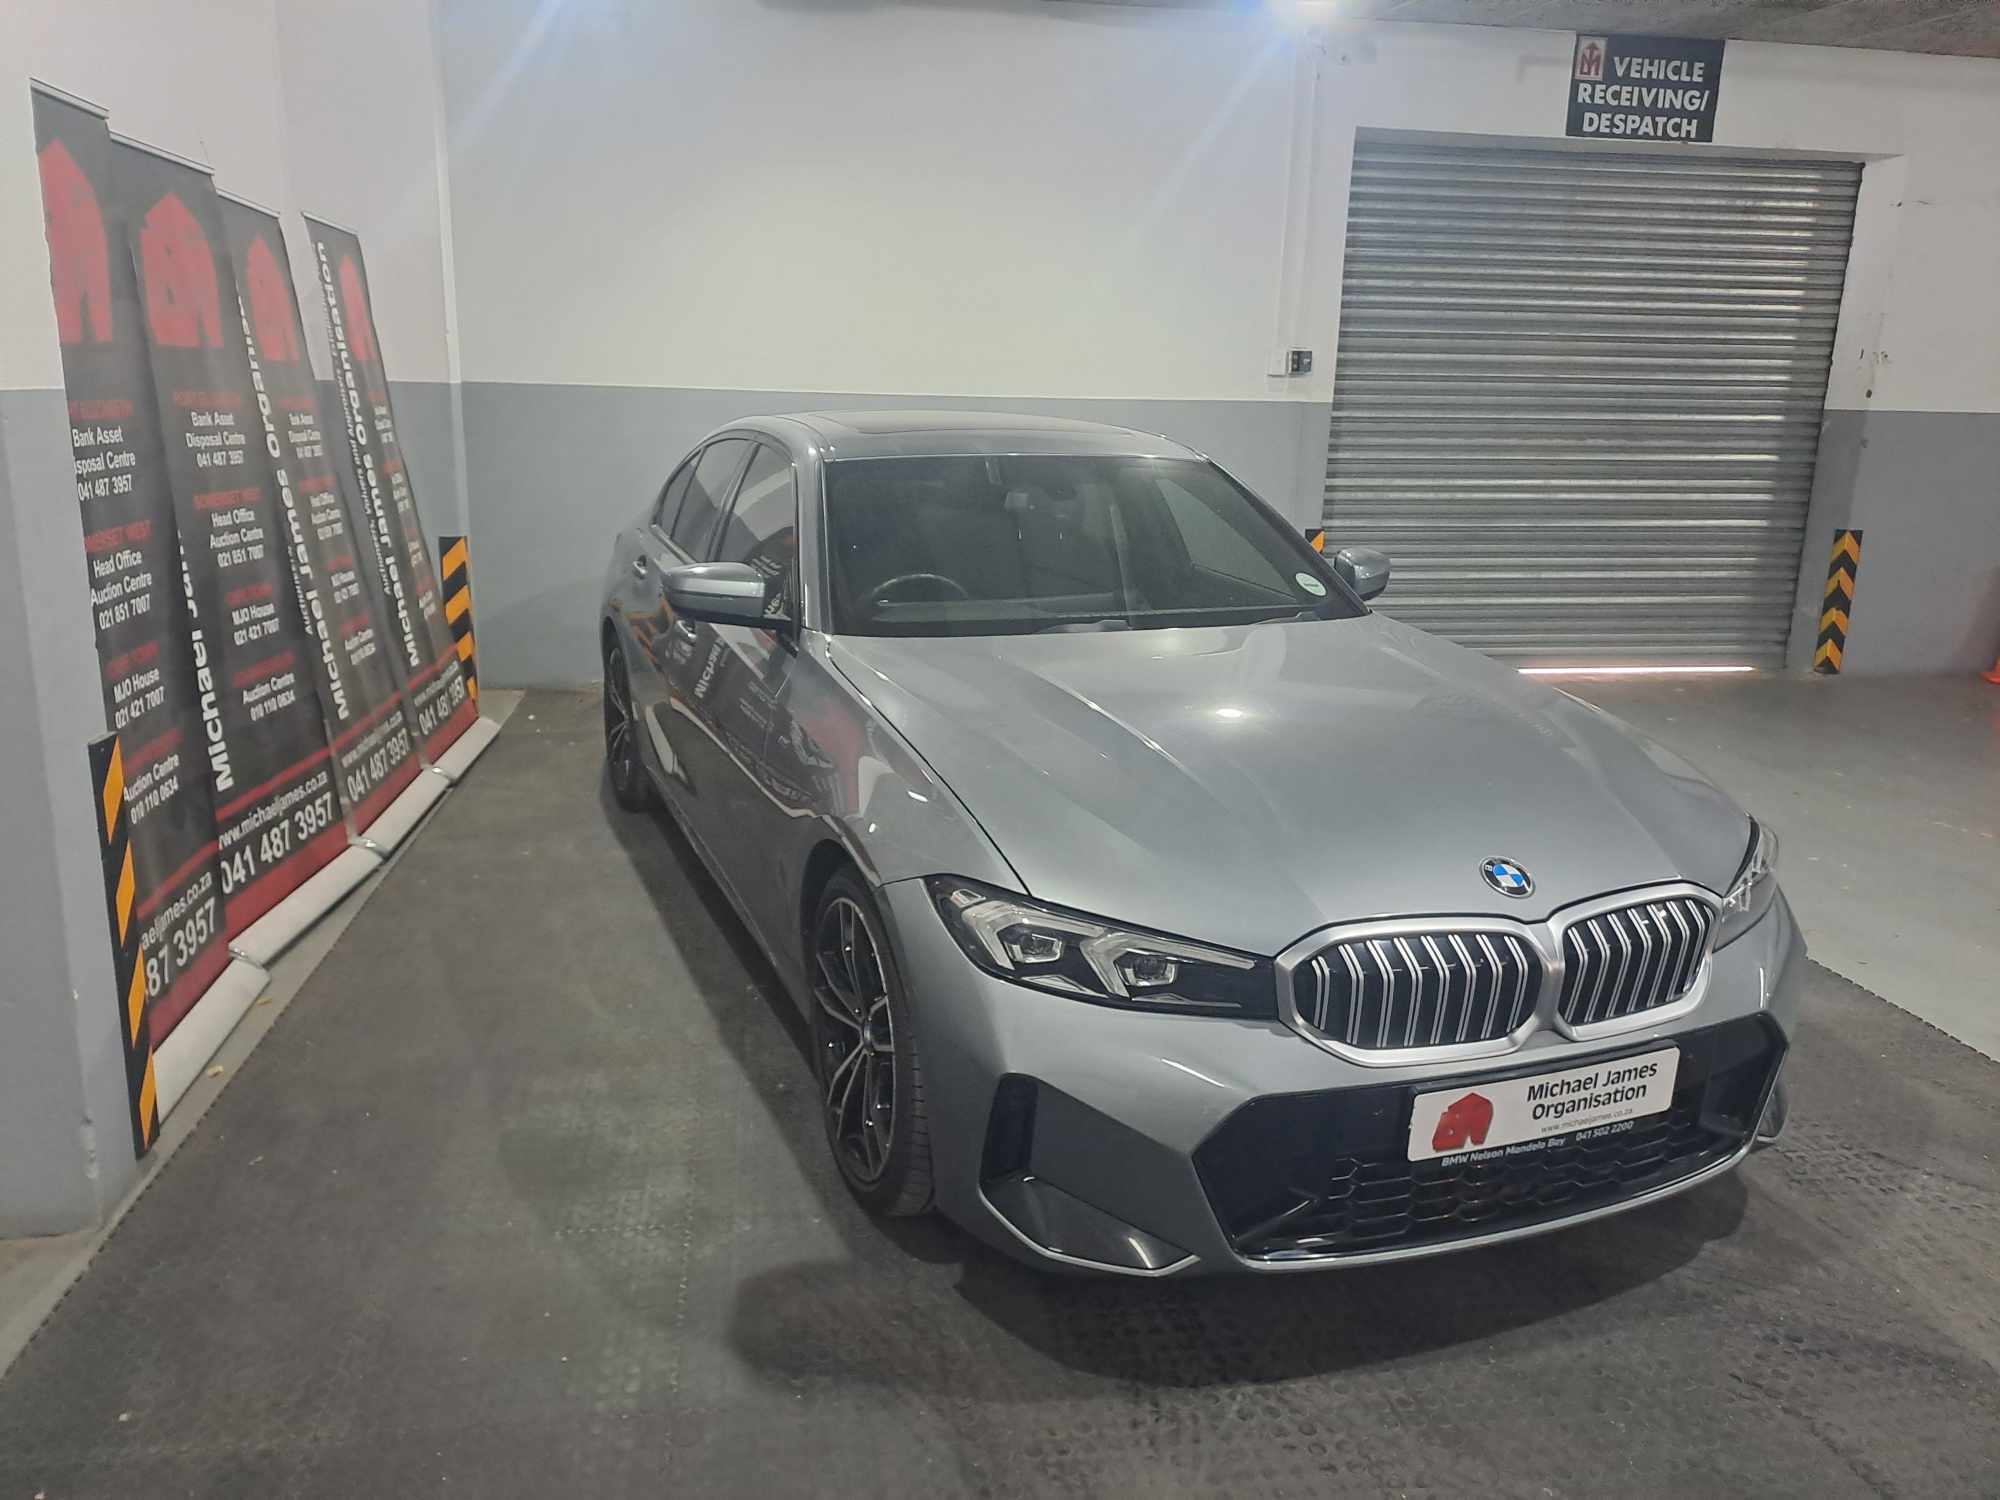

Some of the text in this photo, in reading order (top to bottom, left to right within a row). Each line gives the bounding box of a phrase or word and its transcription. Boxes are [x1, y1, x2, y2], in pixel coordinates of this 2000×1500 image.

[1613, 56, 1705, 83] VEHICLE
[1577, 83, 1710, 112] RECEIVING/
[1582, 112, 1698, 139] DESPATCH
[72, 425, 124, 447] Bank Asset
[106, 450, 136, 469] Centre
[78, 474, 132, 501] 041 487 3957
[276, 468, 313, 580] James
[93, 549, 142, 578] Head Office
[91, 572, 152, 607] Auction Centre
[99, 608, 114, 630] 021
[385, 556, 420, 667] Michael
[305, 589, 350, 720] Michael
[114, 668, 159, 703] MJO House
[115, 706, 129, 729] 021
[123, 772, 153, 801] Auction
[347, 764, 371, 802] 041
[369, 747, 388, 781] 487
[220, 791, 332, 894] 041 487 3957
[145, 896, 215, 1000] 87 3957
[1527, 1063, 1658, 1102] Michael James
[1532, 1084, 1647, 1120] Organisation
[1442, 1154, 1471, 1167] BMW
[1471, 1149, 1503, 1161] Nelson
[1505, 1142, 1547, 1155] Mandela
